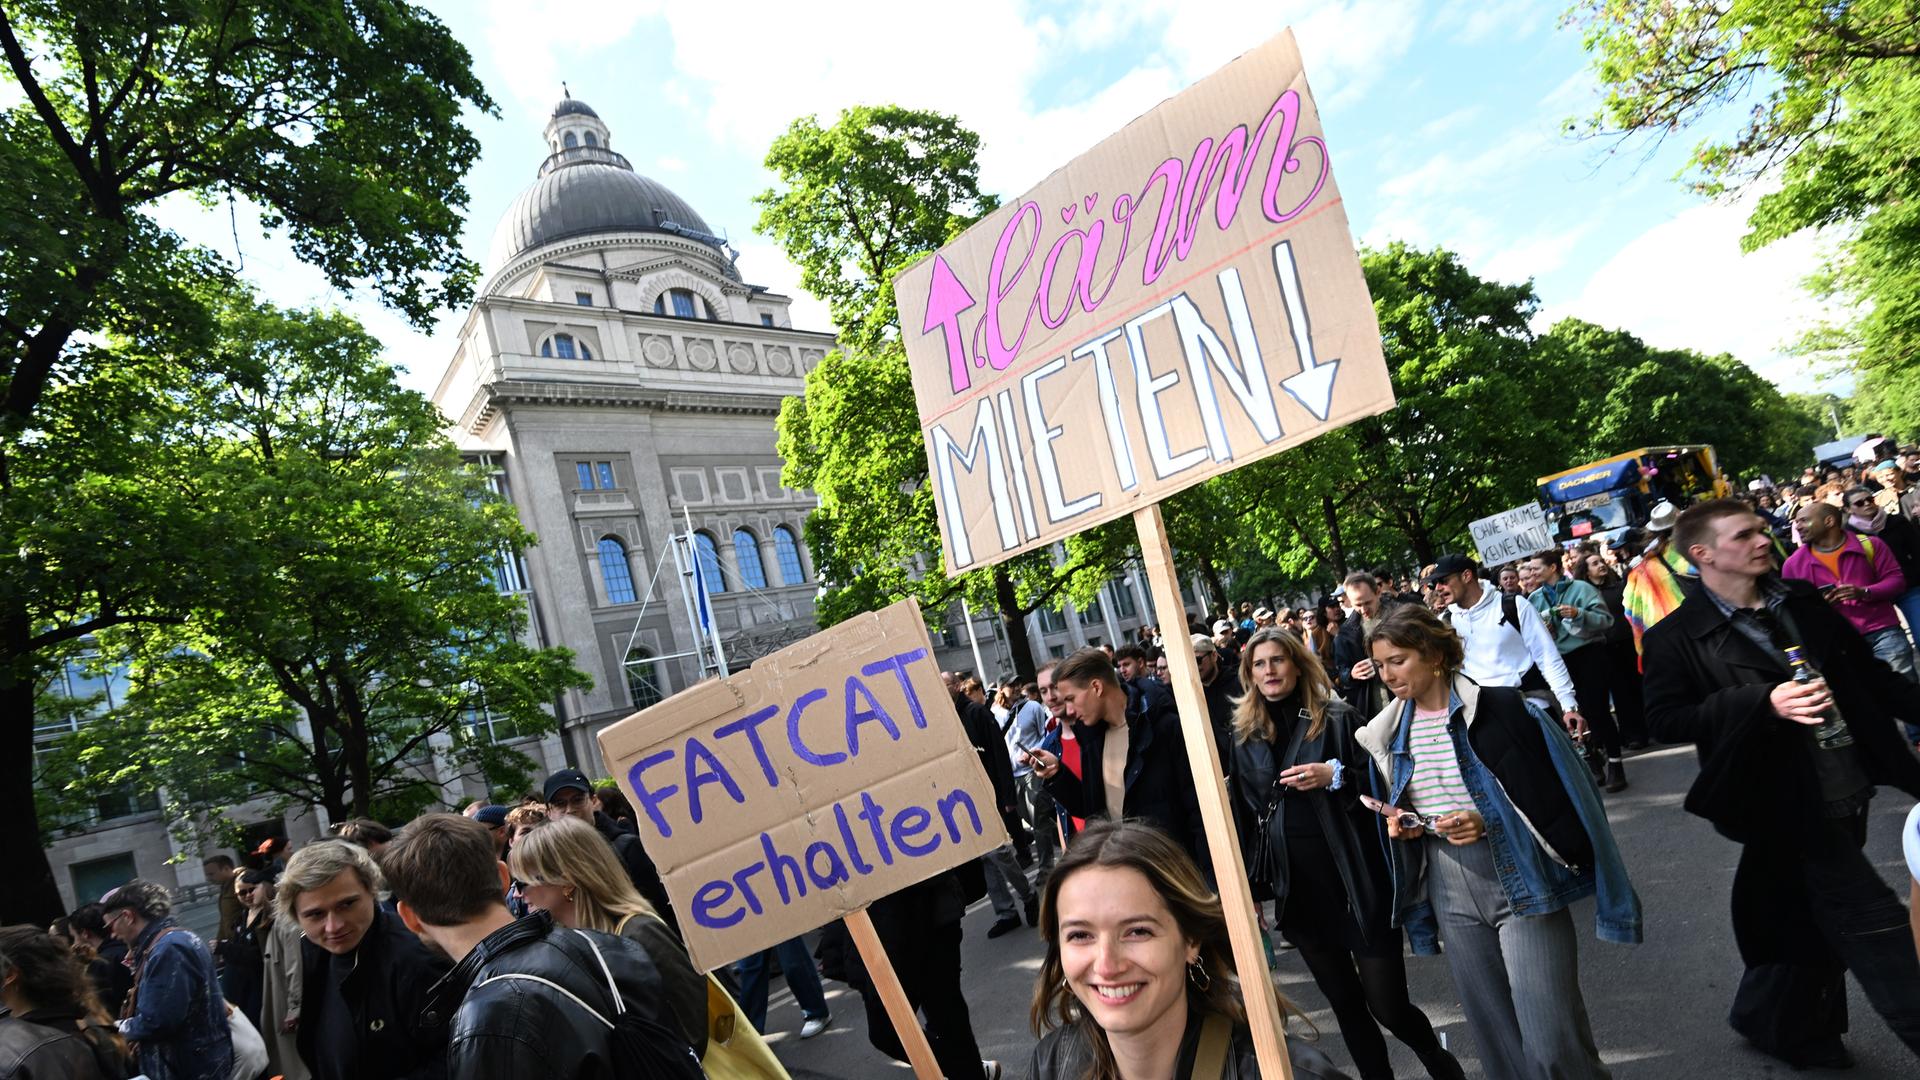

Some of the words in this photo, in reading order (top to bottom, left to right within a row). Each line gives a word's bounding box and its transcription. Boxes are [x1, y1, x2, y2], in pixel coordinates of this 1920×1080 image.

[973, 89, 1329, 371] lärm
[1558, 469, 1612, 490] DACHSER
[1473, 518, 1501, 541] OHNE
[1482, 538, 1515, 564] KEINE
[627, 647, 928, 838] FATCAT
[691, 789, 983, 929] erhalten
